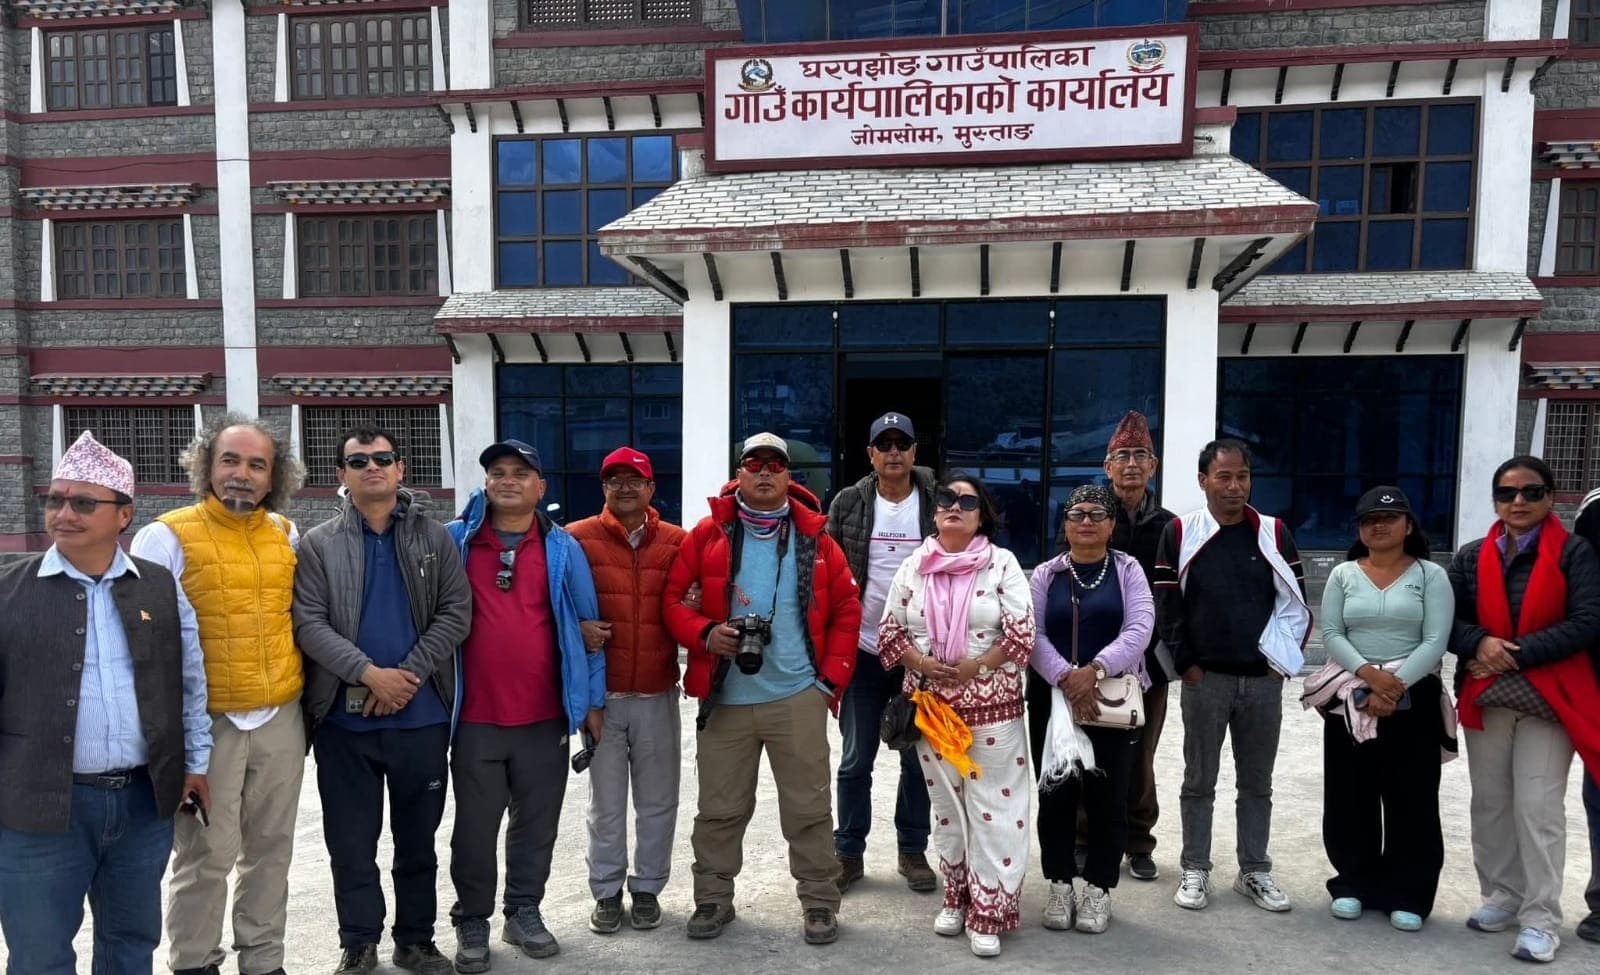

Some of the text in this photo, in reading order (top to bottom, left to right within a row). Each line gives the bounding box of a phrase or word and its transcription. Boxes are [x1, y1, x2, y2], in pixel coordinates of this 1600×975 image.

[799, 44, 1095, 81] घरपझोङ गाउँपालिका
[724, 69, 1174, 123] गाउँ कार्यपालिकाको कार्यालय
[850, 123, 1034, 149] जोमसोम, मुस्ताङ
